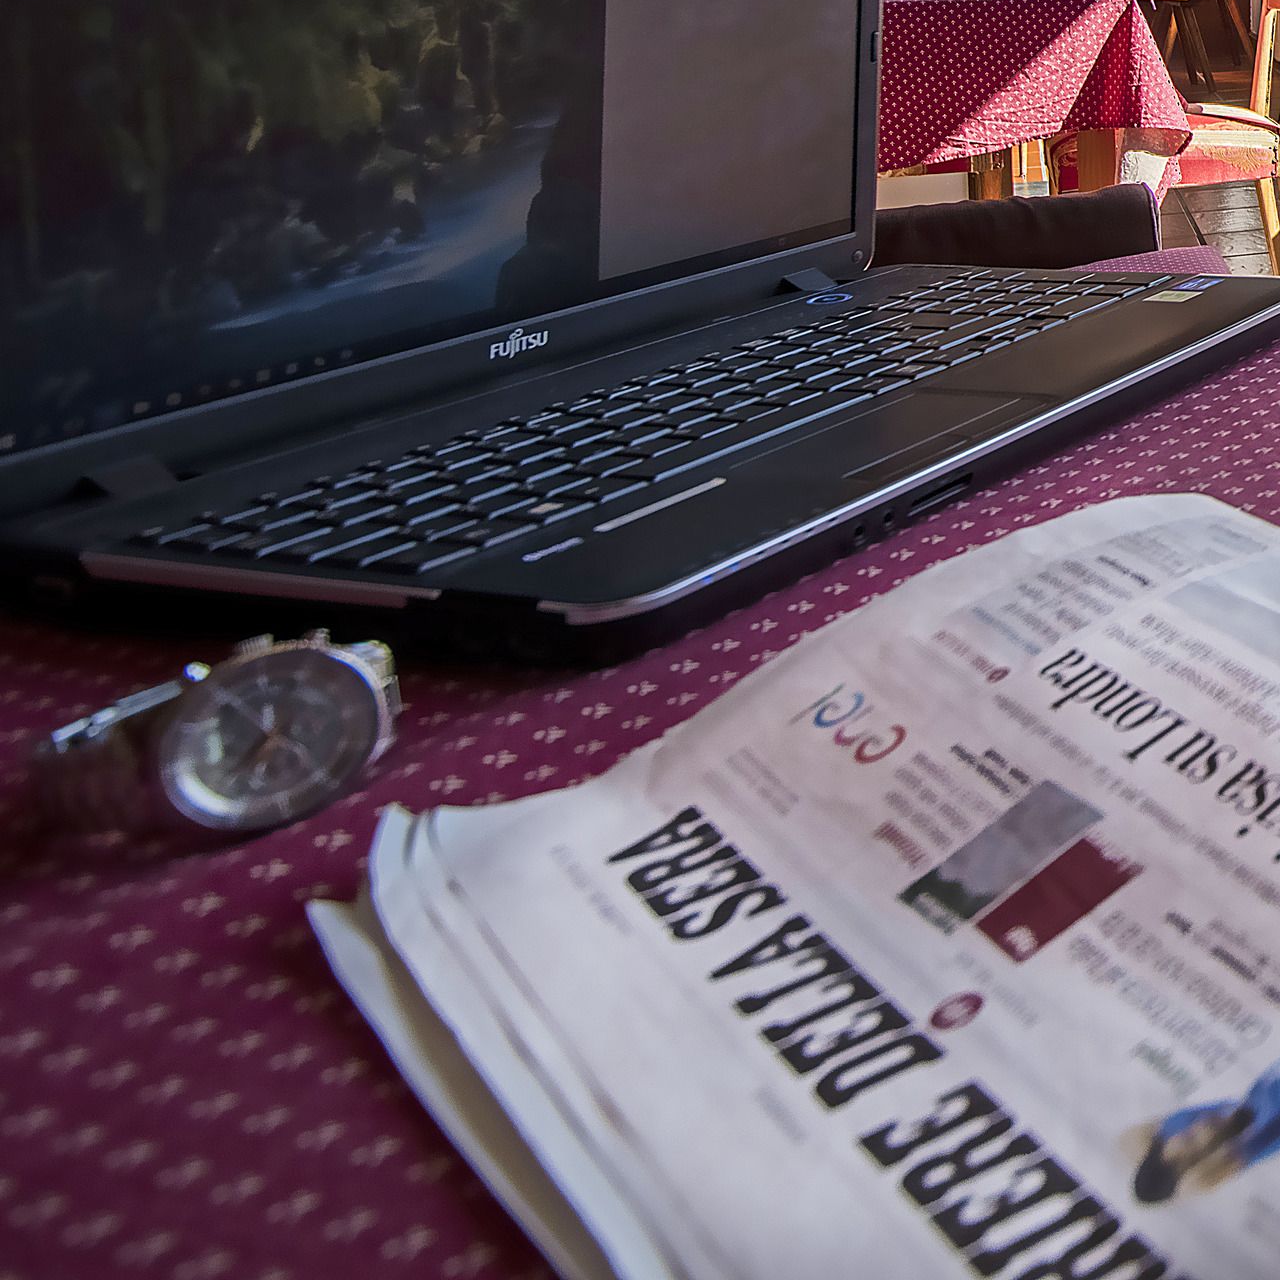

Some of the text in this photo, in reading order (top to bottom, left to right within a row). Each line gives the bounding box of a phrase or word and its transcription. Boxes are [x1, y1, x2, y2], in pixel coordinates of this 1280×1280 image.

[490, 328, 549, 360] FUJITSU
[788, 682, 907, 764] enel
[1039, 647, 1186, 762] Londra
[1164, 728, 1238, 785] su
[605, 804, 790, 943] SERA
[707, 912, 947, 1109] DELLA
